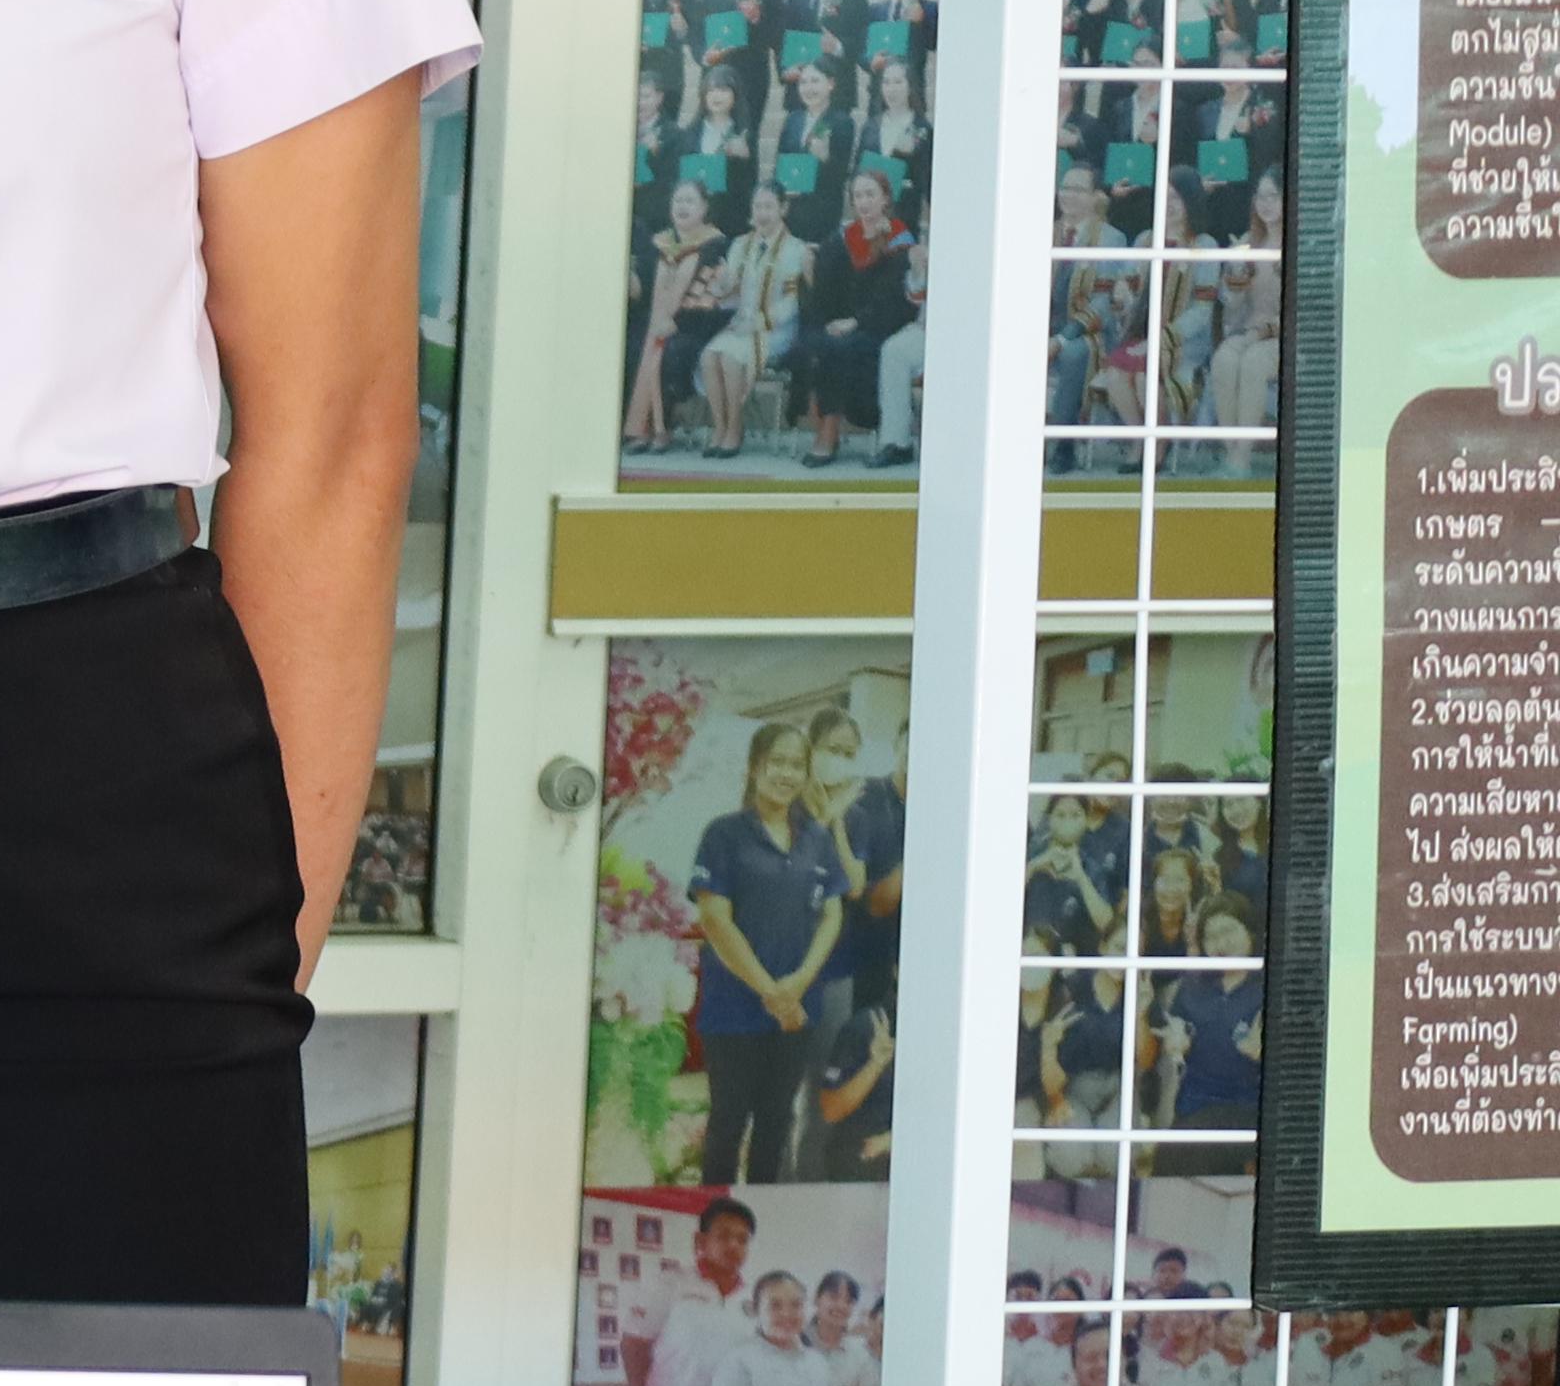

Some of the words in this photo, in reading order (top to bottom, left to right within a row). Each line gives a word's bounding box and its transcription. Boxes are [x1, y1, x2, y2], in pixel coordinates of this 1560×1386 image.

[1449, 114, 1552, 149] Module)
[1415, 514, 1503, 540] เกษตร
[1403, 1013, 1518, 1049] Farming)
